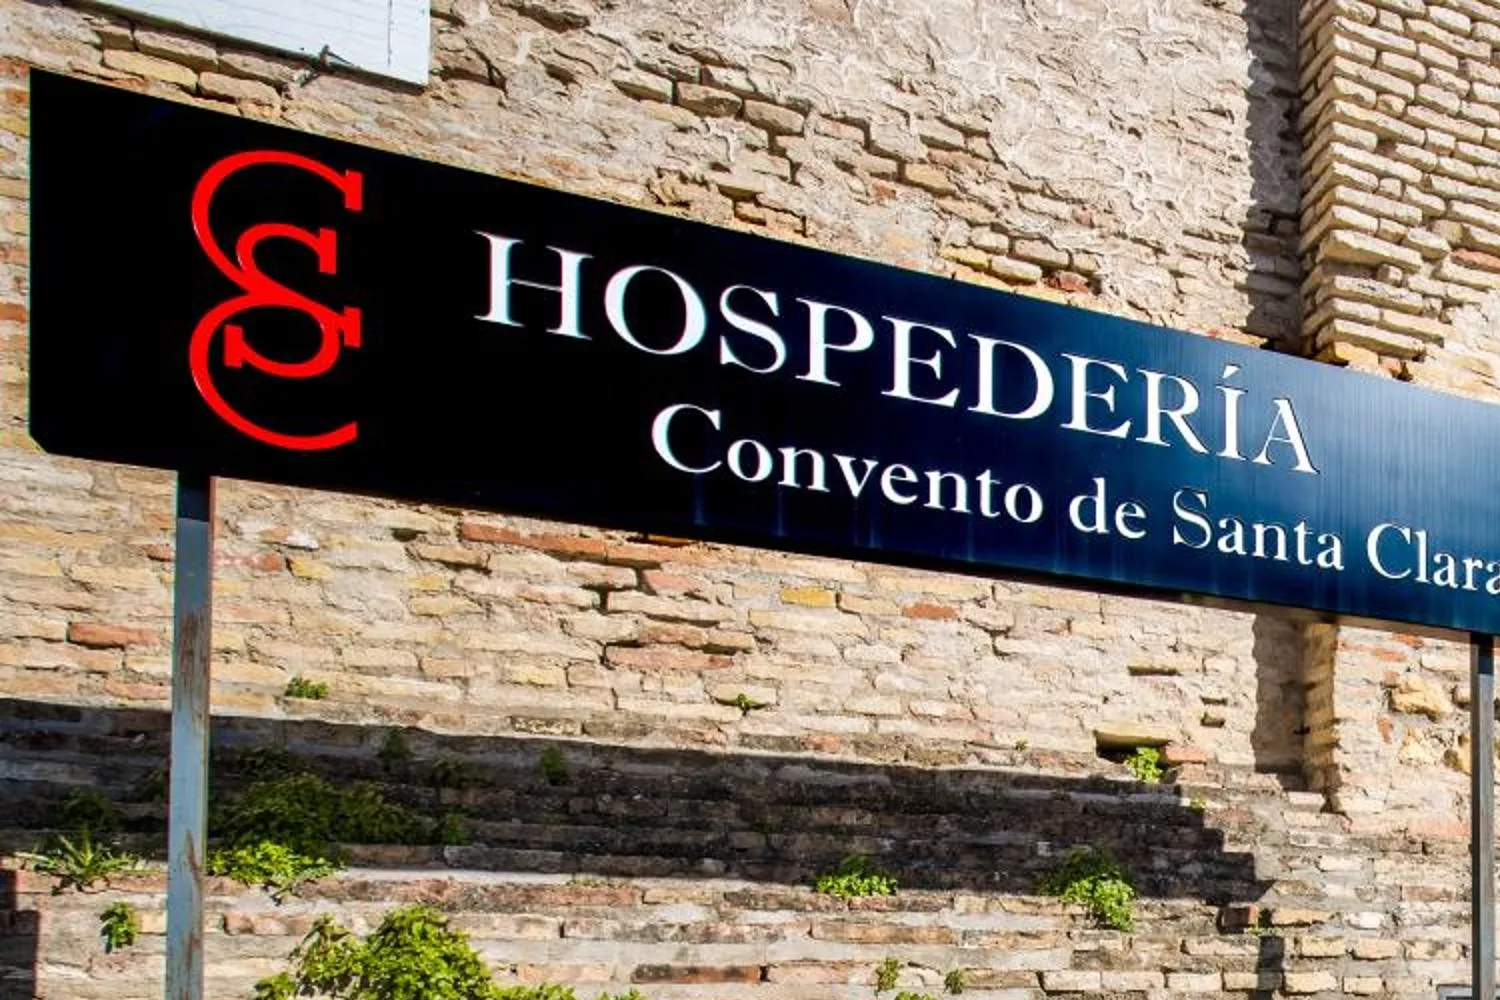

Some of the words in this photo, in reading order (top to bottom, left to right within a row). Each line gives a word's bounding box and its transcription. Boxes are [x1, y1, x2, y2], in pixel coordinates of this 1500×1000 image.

[474, 230, 1318, 474] HOSPEDERÍA
[650, 402, 1044, 524] Convento
[1068, 476, 1146, 539] de
[1172, 489, 1345, 571] Santa
